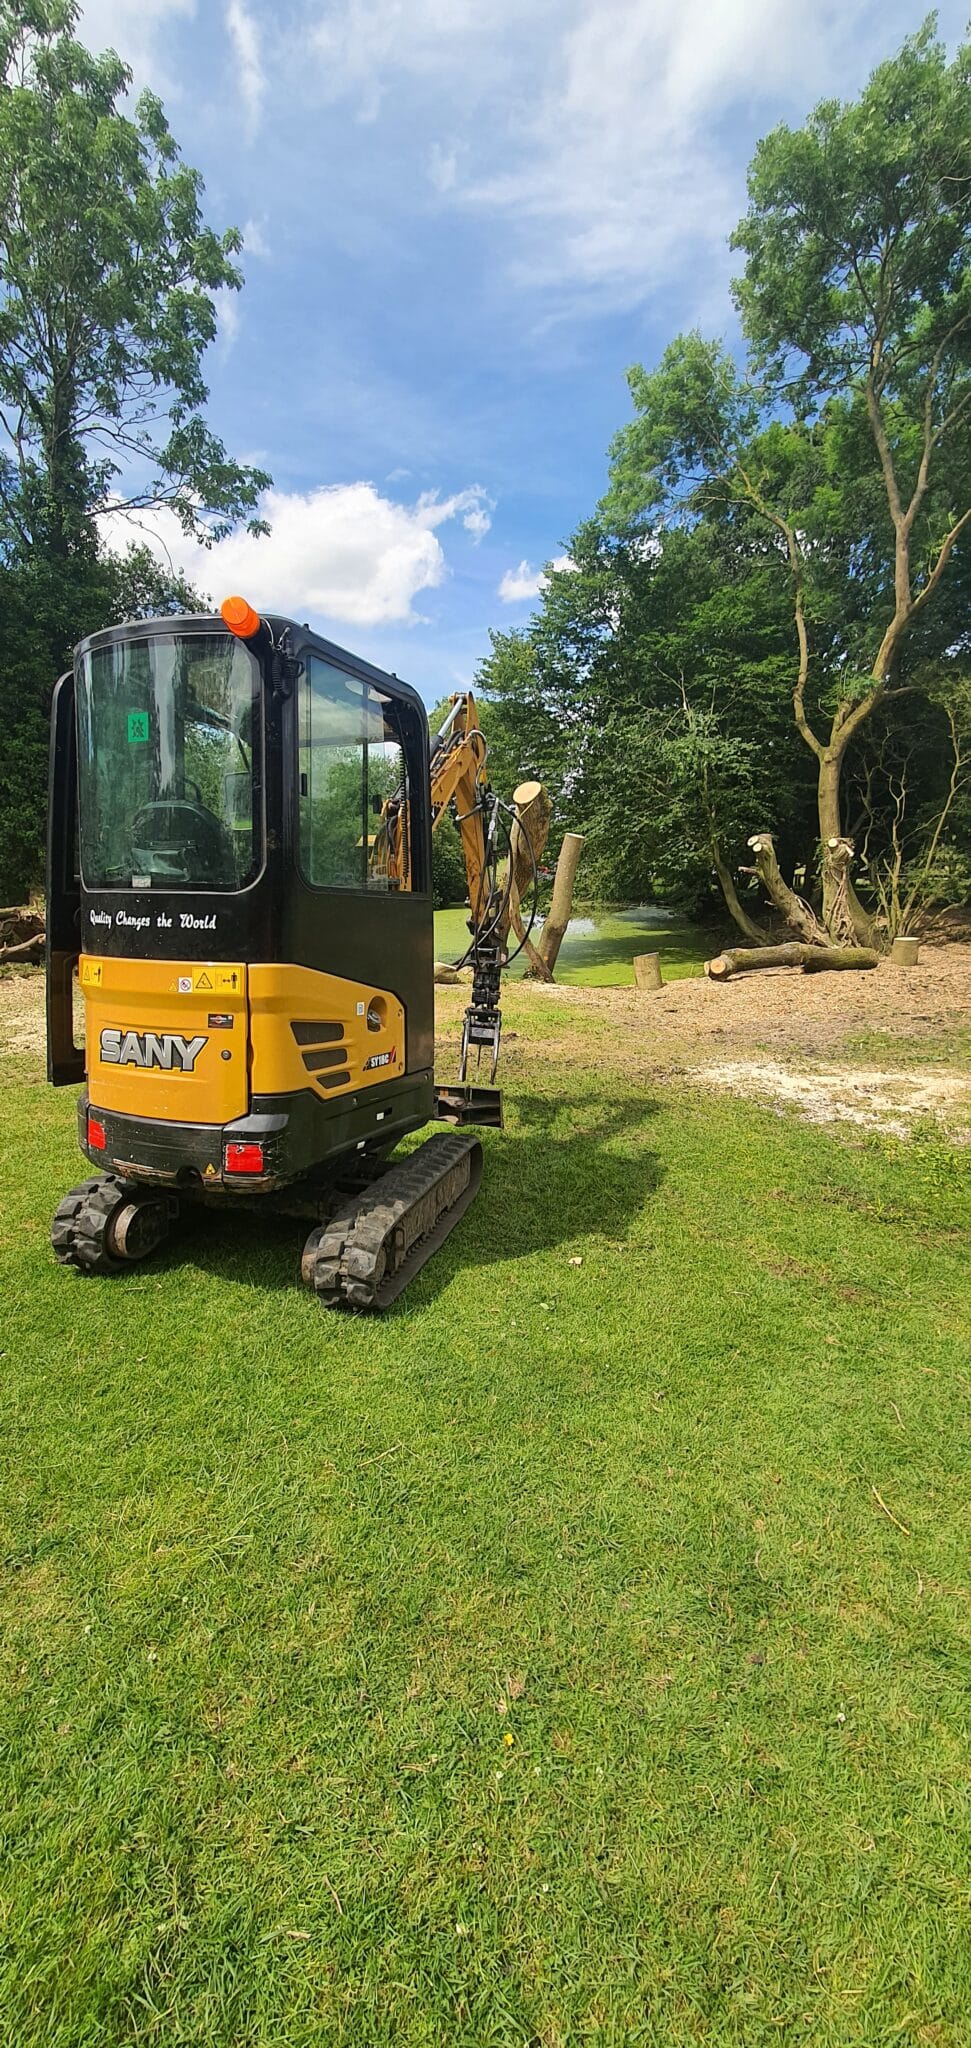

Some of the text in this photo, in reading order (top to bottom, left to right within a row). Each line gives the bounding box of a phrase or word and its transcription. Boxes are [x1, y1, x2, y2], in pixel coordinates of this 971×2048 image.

[90, 909, 217, 931] Quality Changes the World
[101, 1029, 208, 1071] SANY
